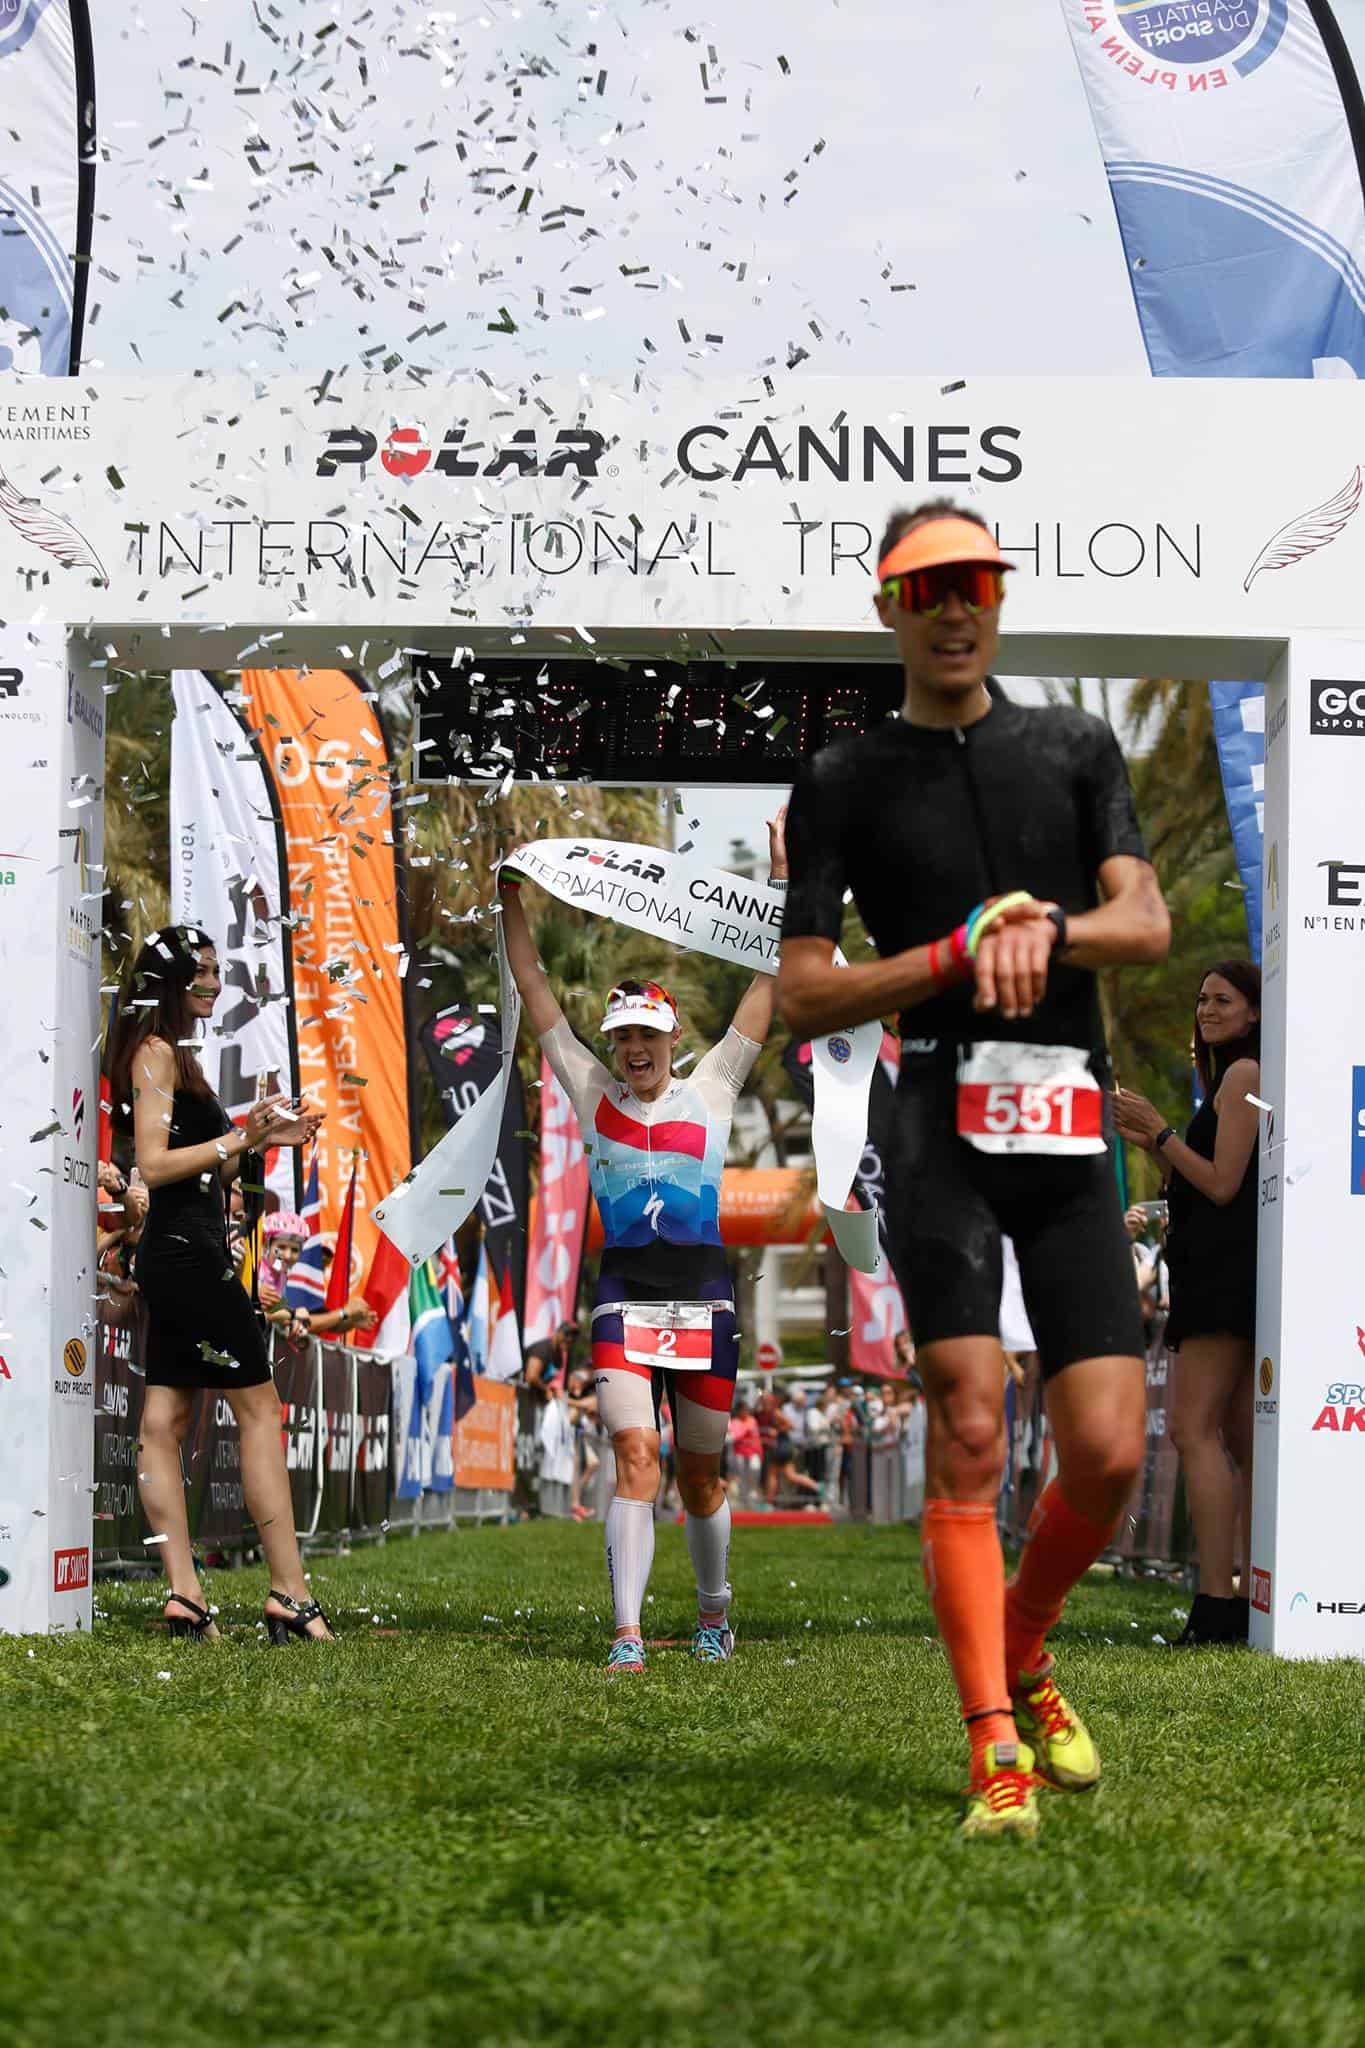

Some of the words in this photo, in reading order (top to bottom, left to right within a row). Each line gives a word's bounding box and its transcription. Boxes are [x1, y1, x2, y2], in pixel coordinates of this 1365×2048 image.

[0, 406, 91, 421] EMENT
[315, 427, 608, 478] POLAR
[677, 425, 1023, 483] CANNES
[136, 519, 735, 577] INTERNATIONAL
[782, 520, 1202, 578] TRHLON
[275, 740, 352, 789] 06
[566, 845, 666, 884] POLAR
[689, 879, 784, 928] CANNE
[1327, 864, 1365, 906] E
[711, 919, 781, 959] TRIAT
[1334, 918, 1354, 931] EN
[983, 1086, 1073, 1134] 551
[657, 1330, 677, 1356] 2
[54, 1379, 71, 1394] RUDY
[57, 1557, 70, 1585] DT
